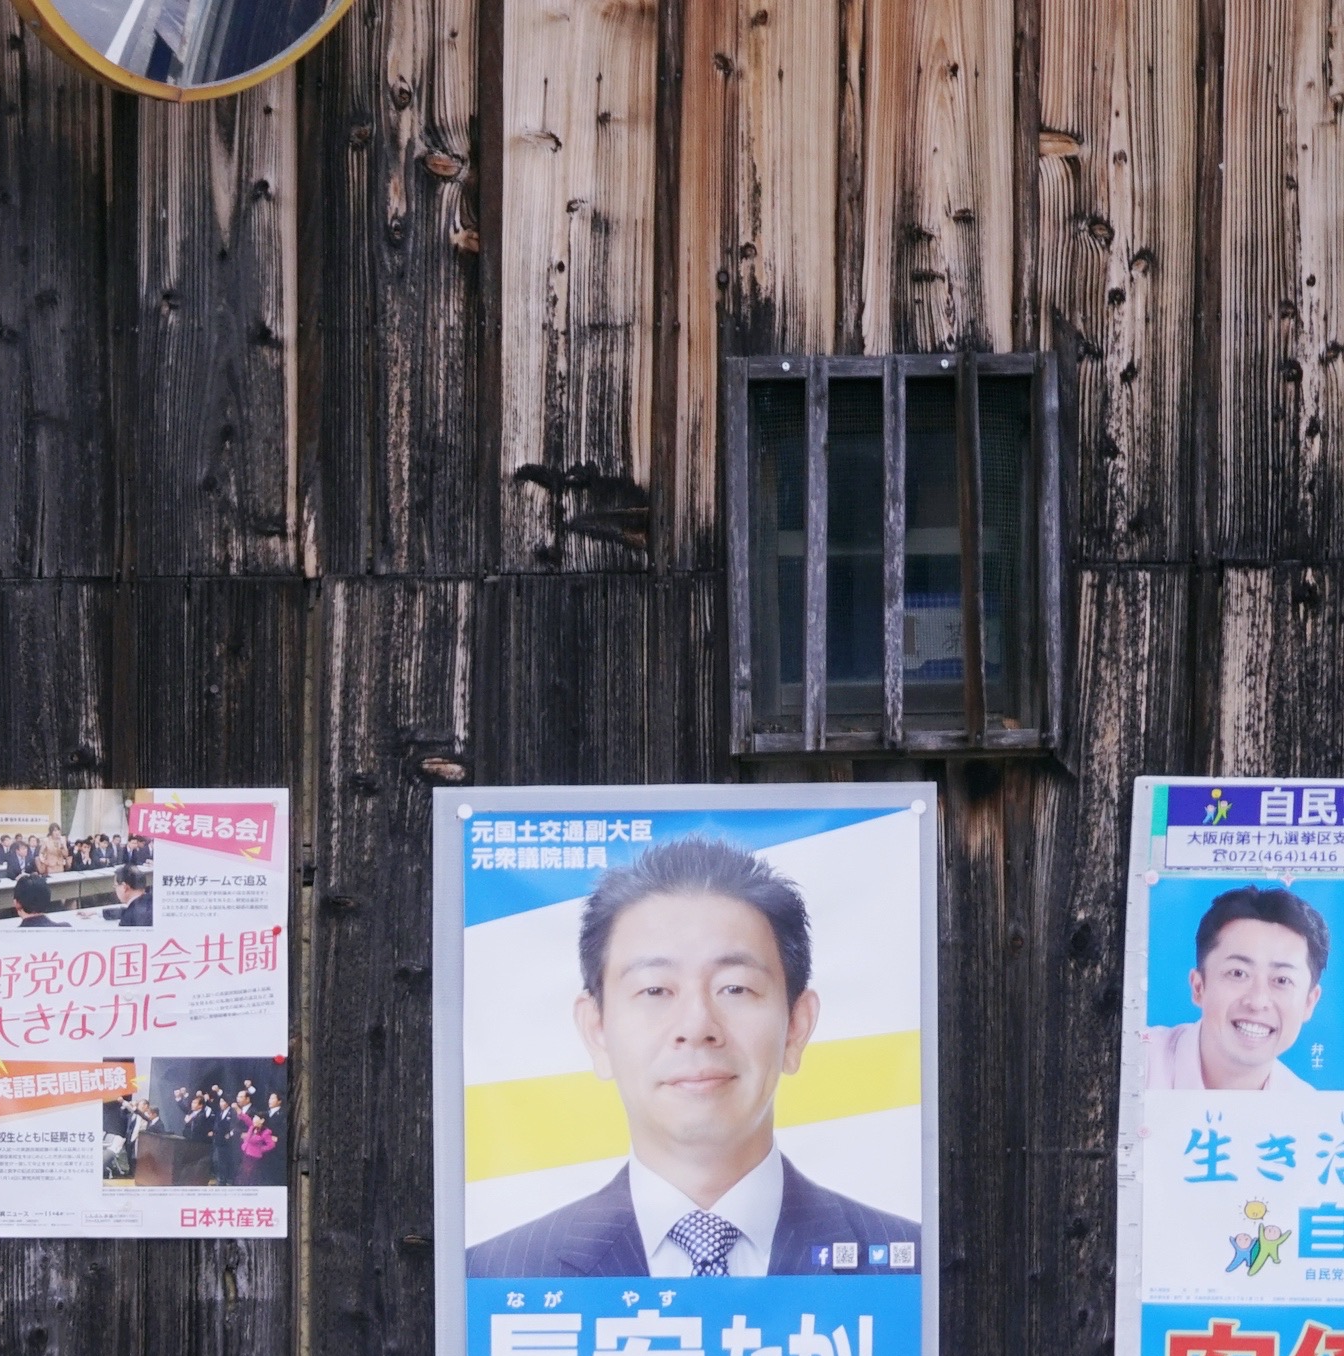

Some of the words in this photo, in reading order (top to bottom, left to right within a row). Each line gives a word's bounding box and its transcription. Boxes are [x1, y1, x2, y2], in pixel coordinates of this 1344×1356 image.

[1260, 787, 1344, 826] 自民
[138, 808, 268, 843] 「桜を見る会」
[471, 819, 653, 843] 元国土交通副大臣
[471, 846, 609, 870] 元衆議院議員
[162, 875, 267, 887] 野党がチームで追及
[1311, 1042, 1324, 1069] 弁士
[180, 1207, 275, 1228] 日本共産党
[1305, 1267, 1344, 1281] 自民党
